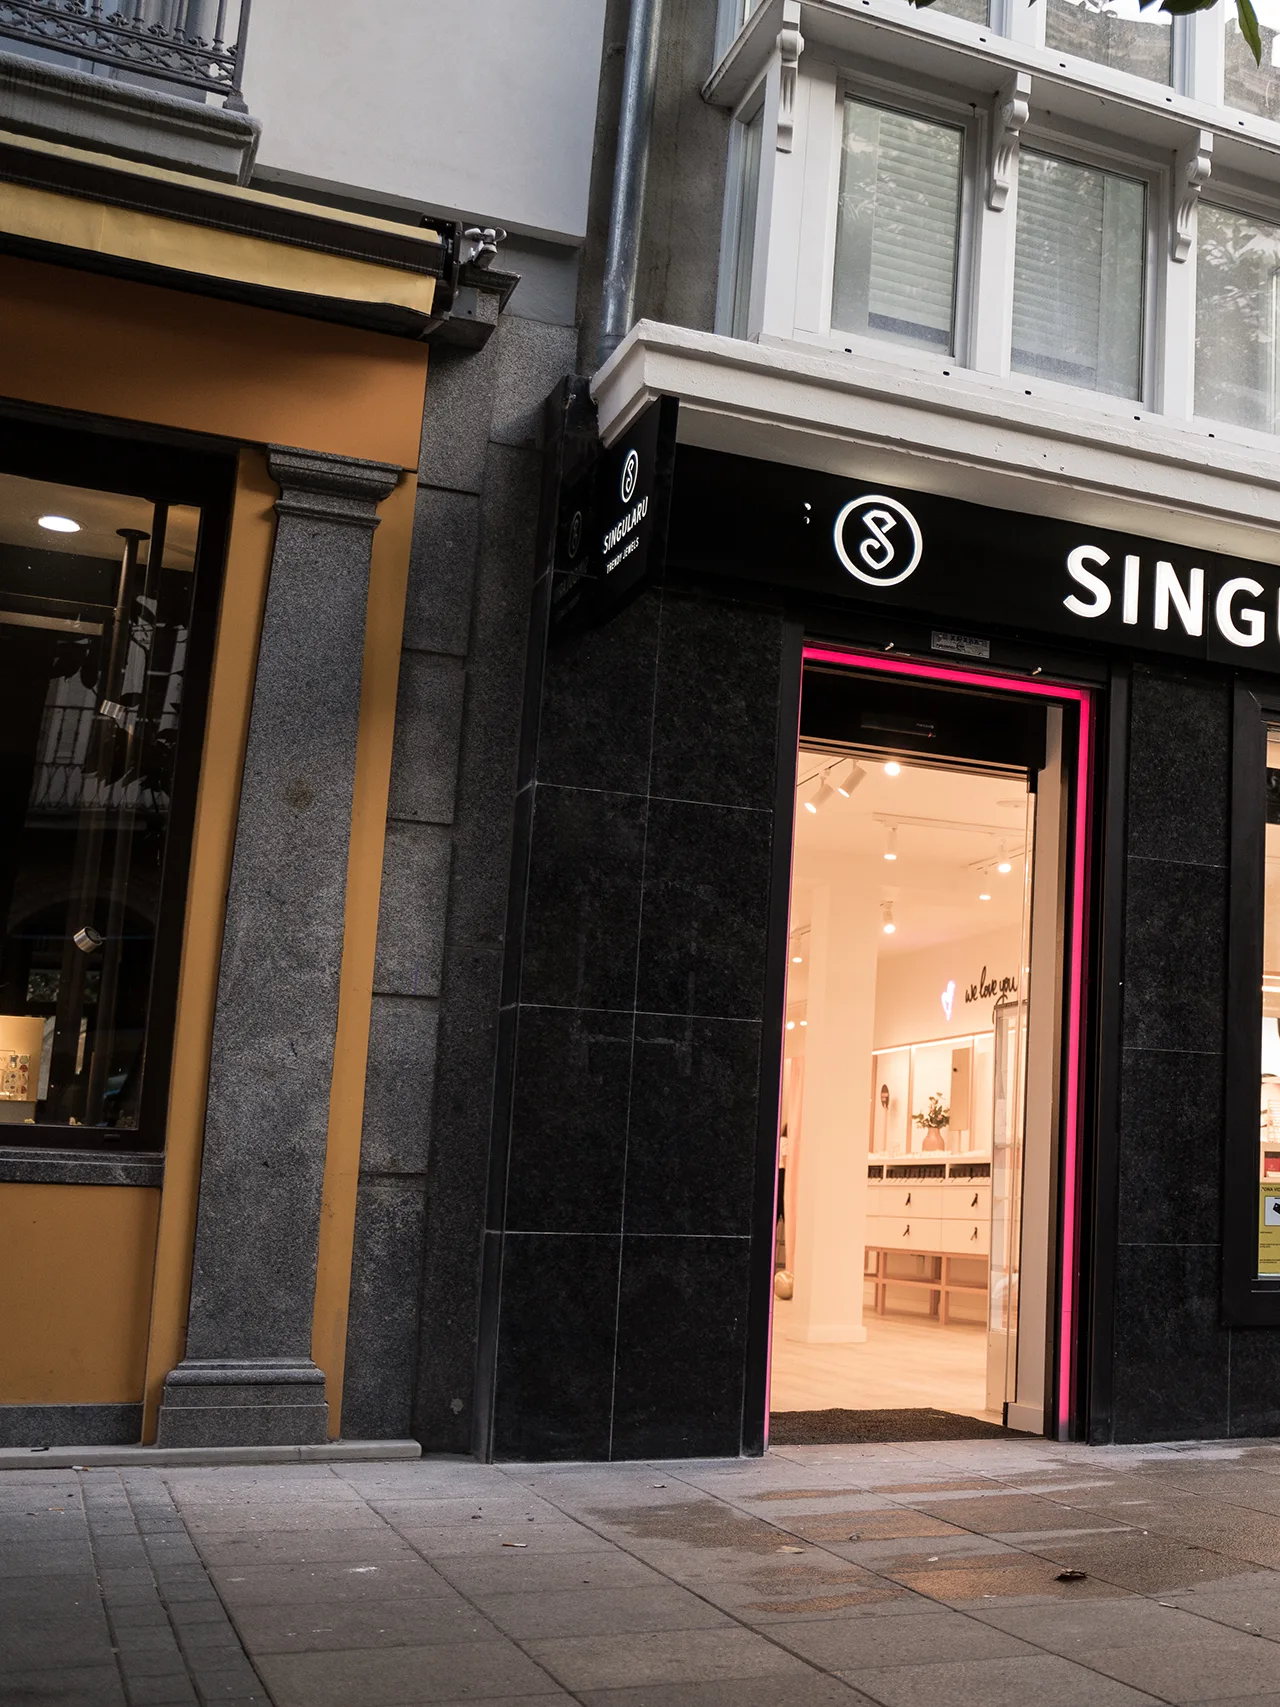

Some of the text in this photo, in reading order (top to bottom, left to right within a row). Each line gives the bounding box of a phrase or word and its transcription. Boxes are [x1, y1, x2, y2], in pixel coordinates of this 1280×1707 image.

[603, 496, 649, 554] SINGULARU
[606, 536, 639, 574] TRENDY JEWELS
[964, 966, 1018, 1003] we love you
